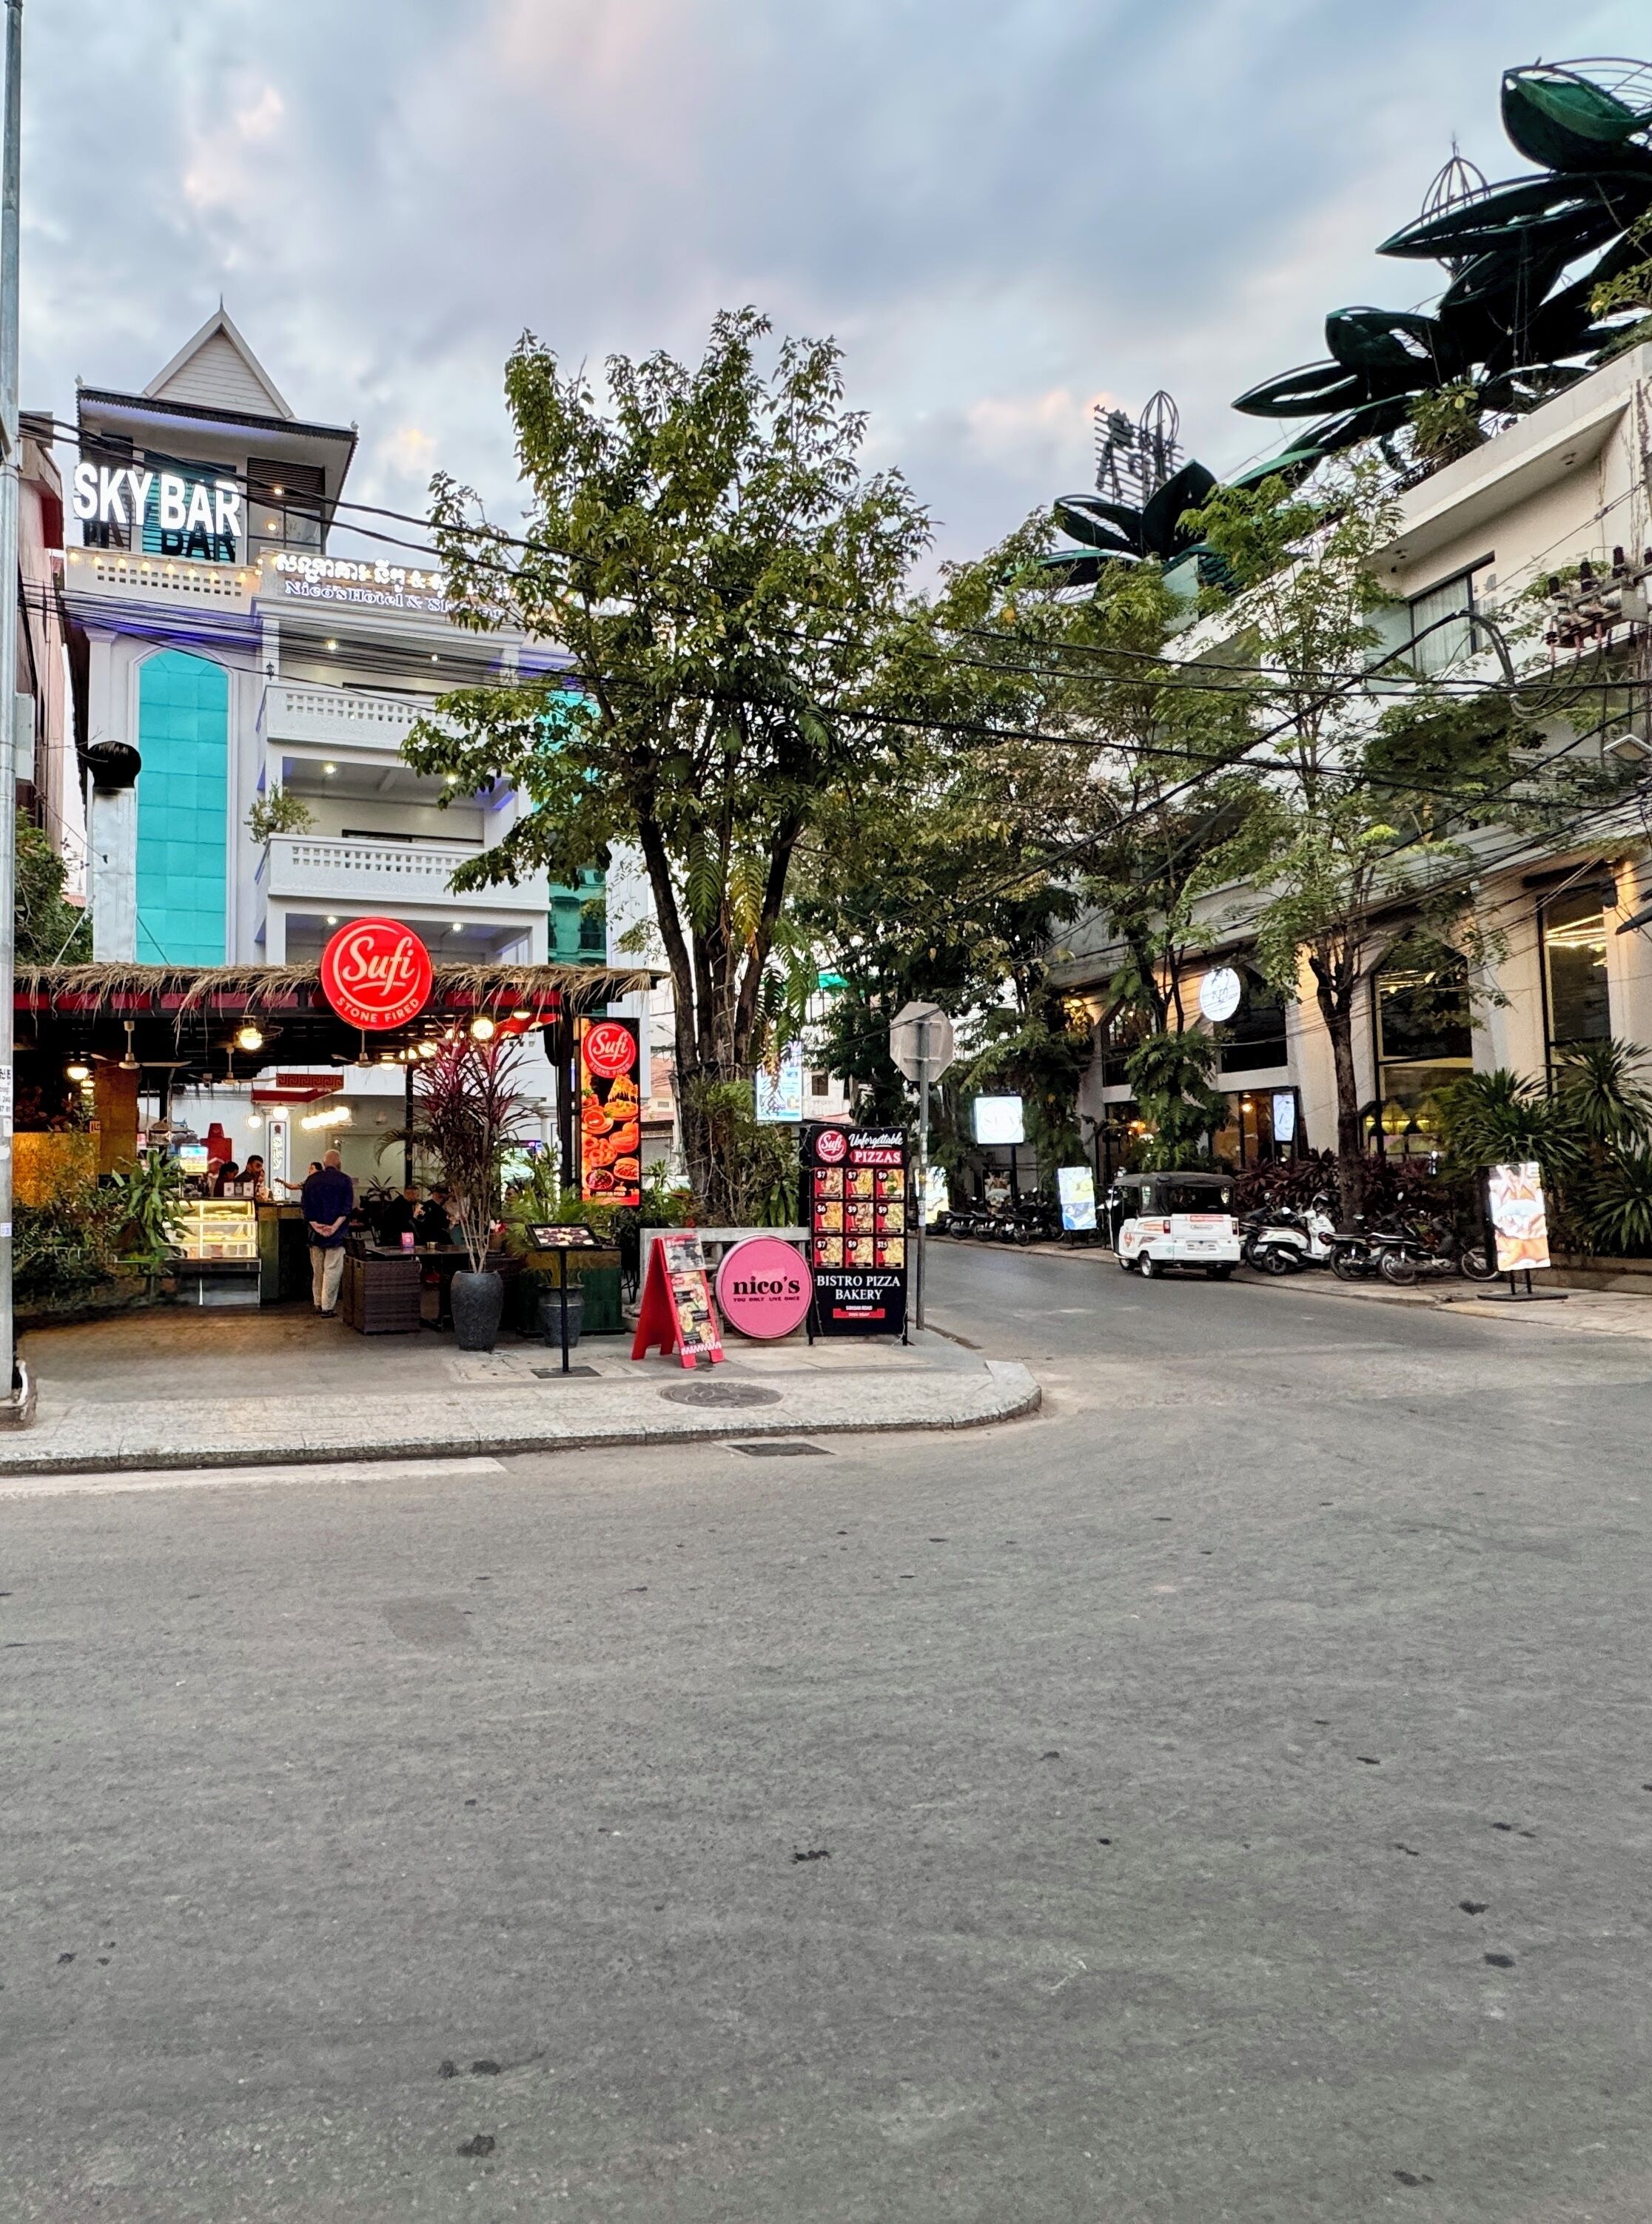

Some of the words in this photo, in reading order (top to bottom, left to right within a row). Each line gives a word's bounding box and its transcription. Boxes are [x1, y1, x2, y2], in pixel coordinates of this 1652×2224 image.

[73, 463, 153, 525] SKY
[160, 473, 242, 537] BAR
[285, 580, 348, 601] Nico's
[349, 588, 404, 608] Hotel
[406, 595, 423, 609] &
[342, 935, 415, 997] Sufi
[336, 997, 377, 1023] STONE
[384, 998, 419, 1023] FIRED
[592, 1031, 629, 1063] Sufi
[821, 1134, 844, 1154] Sufi
[848, 1132, 903, 1149] Unforgettable
[854, 1151, 901, 1163] PIZZAS
[847, 1205, 857, 1213] $9
[878, 1206, 887, 1214] $9
[847, 1240, 857, 1249] $9
[733, 1276, 800, 1294] nico's
[816, 1275, 863, 1286] BISTRO
[866, 1276, 901, 1286] PIZZA
[835, 1289, 883, 1300] BAKERY
